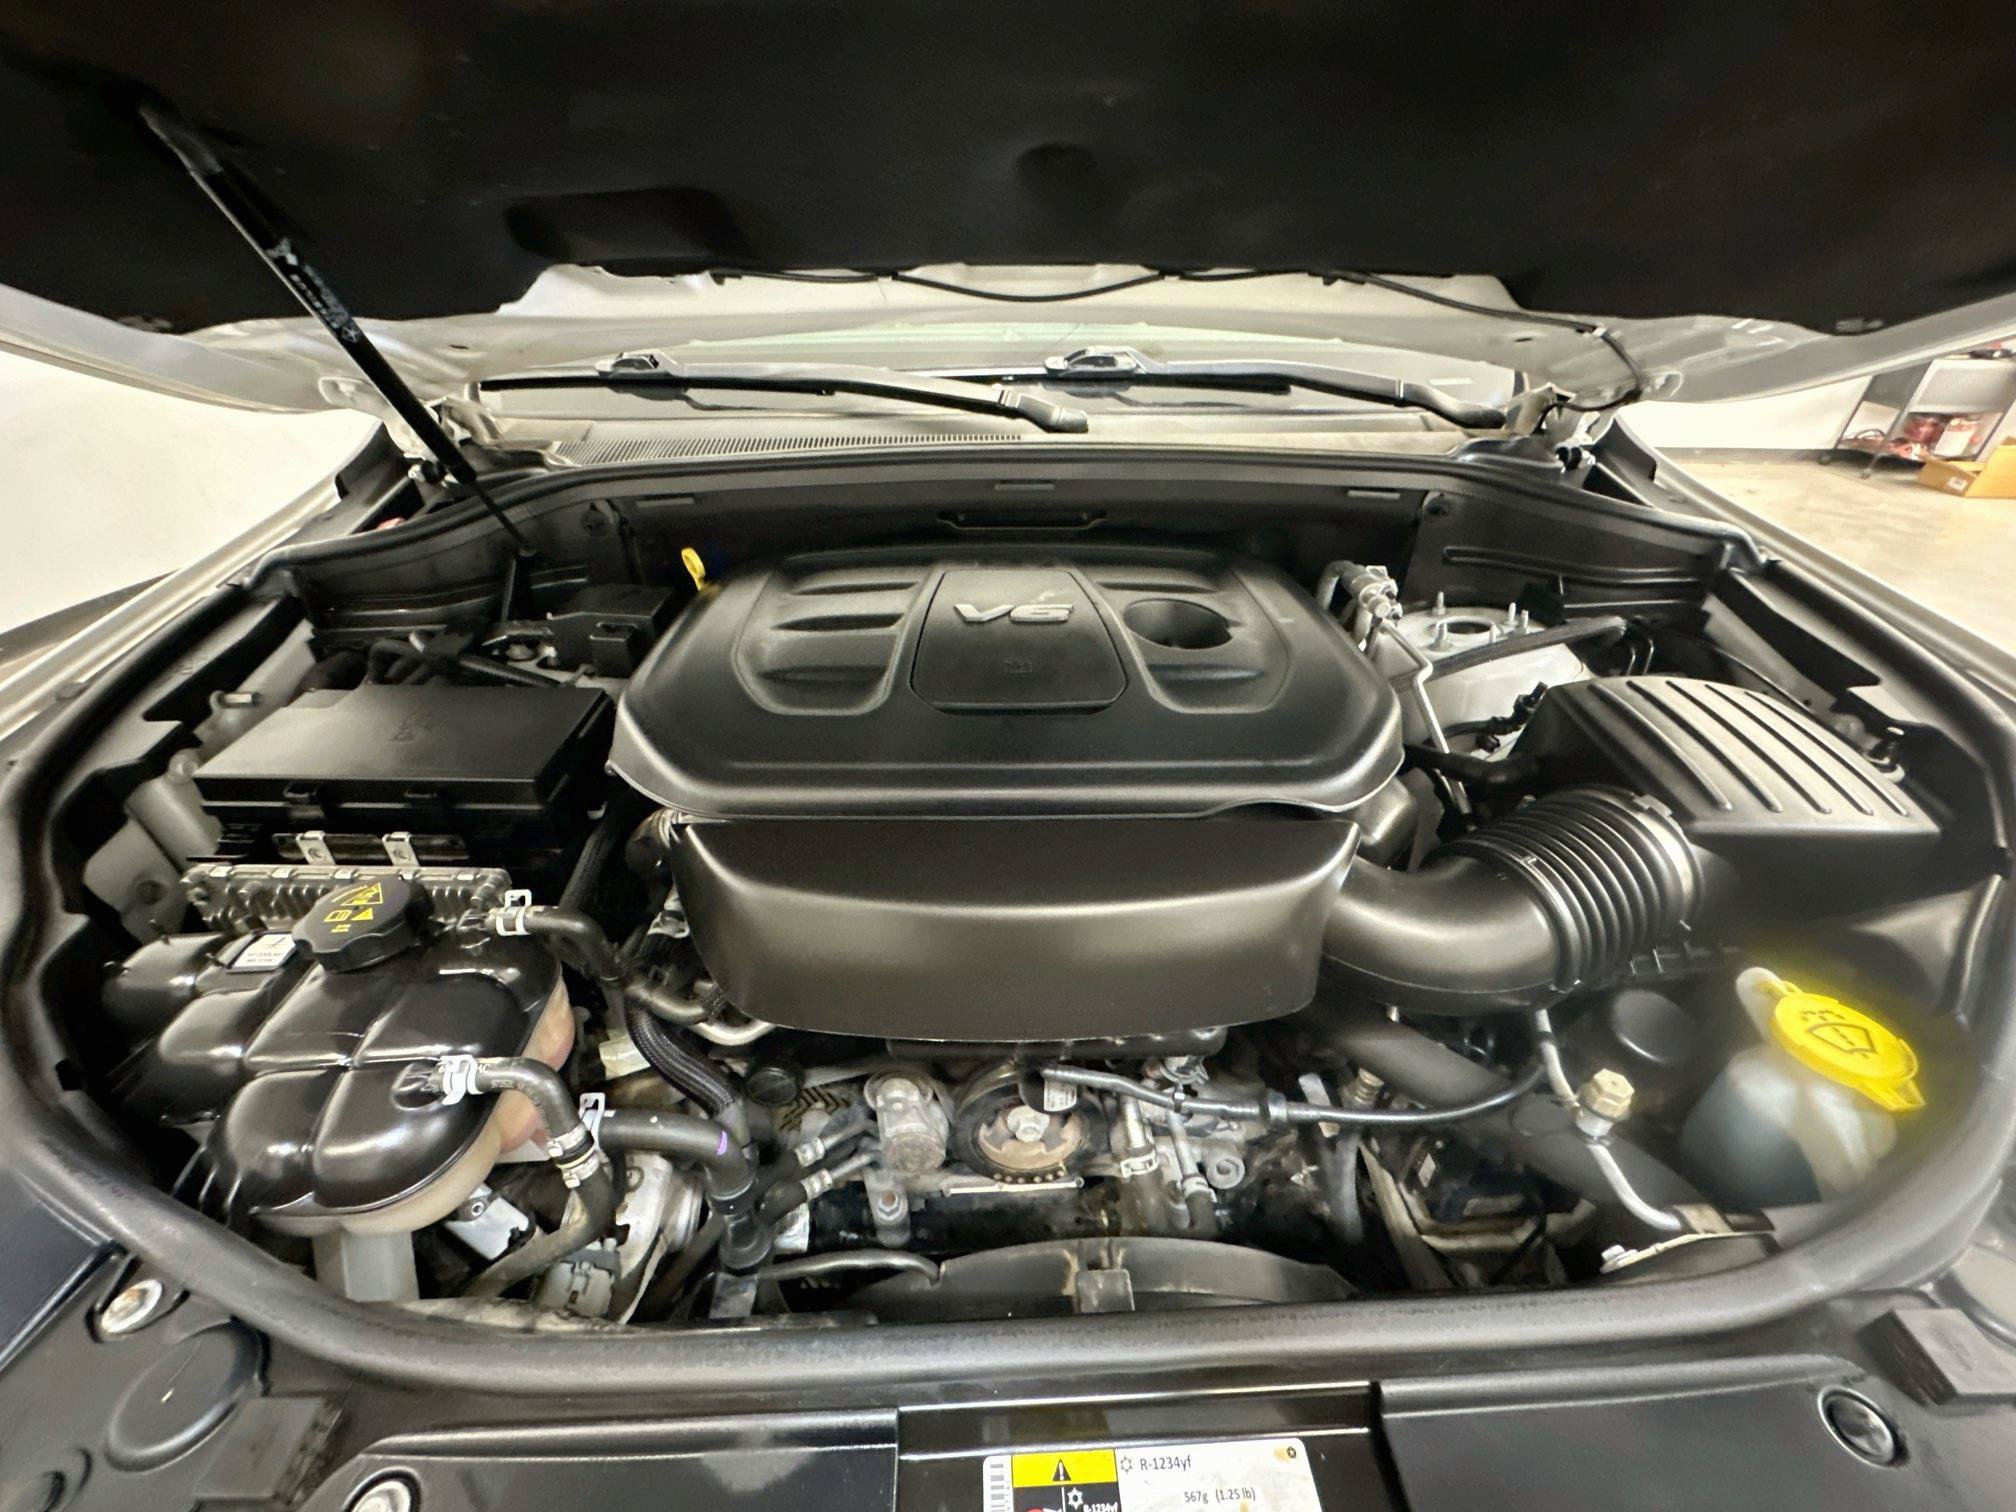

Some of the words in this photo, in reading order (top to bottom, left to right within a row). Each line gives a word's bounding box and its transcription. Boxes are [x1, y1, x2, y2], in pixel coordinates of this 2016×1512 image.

[953, 591, 1074, 623] V6
[1139, 1454, 1192, 1472] R-1234yf
[1184, 1490, 1209, 1505] 567g
[1215, 1488, 1241, 1504] (1.25
[1241, 1486, 1256, 1502] lb)
